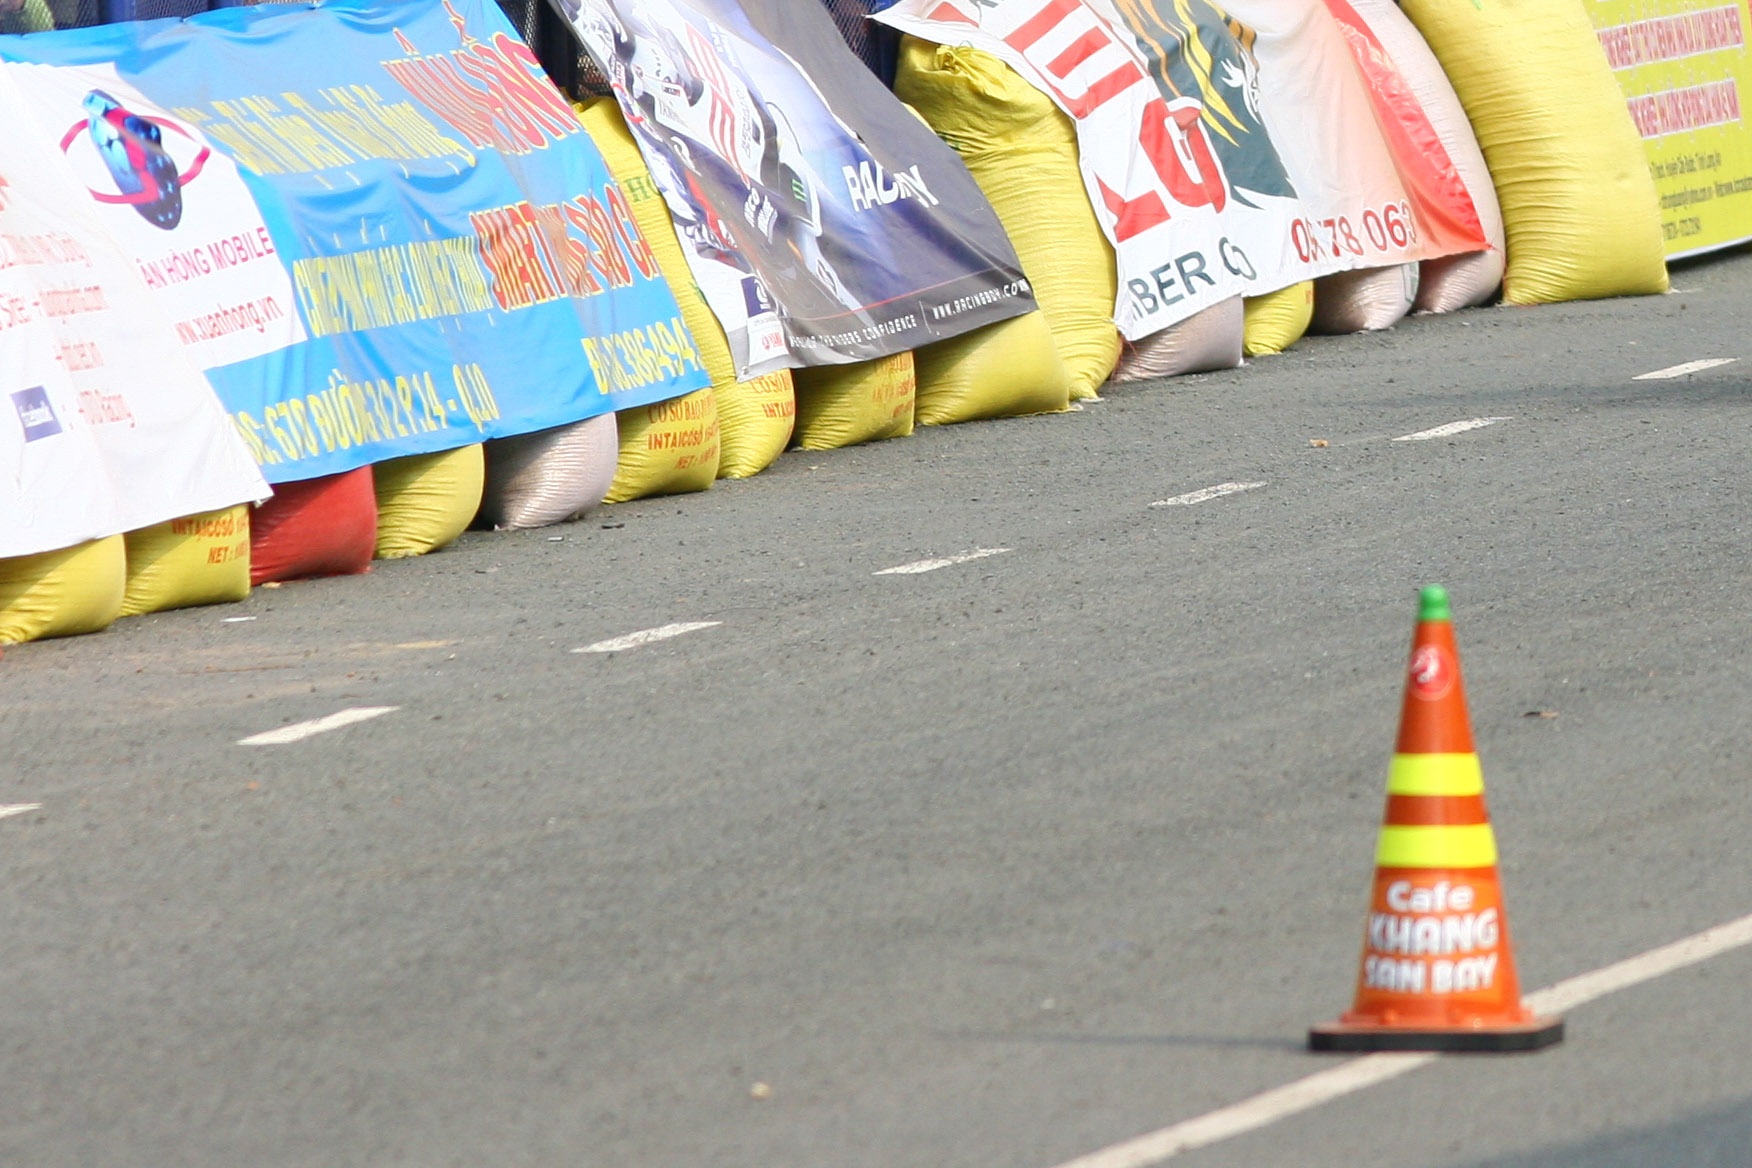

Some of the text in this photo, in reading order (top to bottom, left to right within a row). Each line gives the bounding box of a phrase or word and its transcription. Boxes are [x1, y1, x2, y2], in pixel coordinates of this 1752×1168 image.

[207, 226, 275, 272] MOBILE
[863, 314, 917, 341] CONFIDENCE
[1387, 880, 1474, 913] Cafe
[1370, 909, 1499, 956] KHANG
[1365, 953, 1499, 993] SAN BAY
